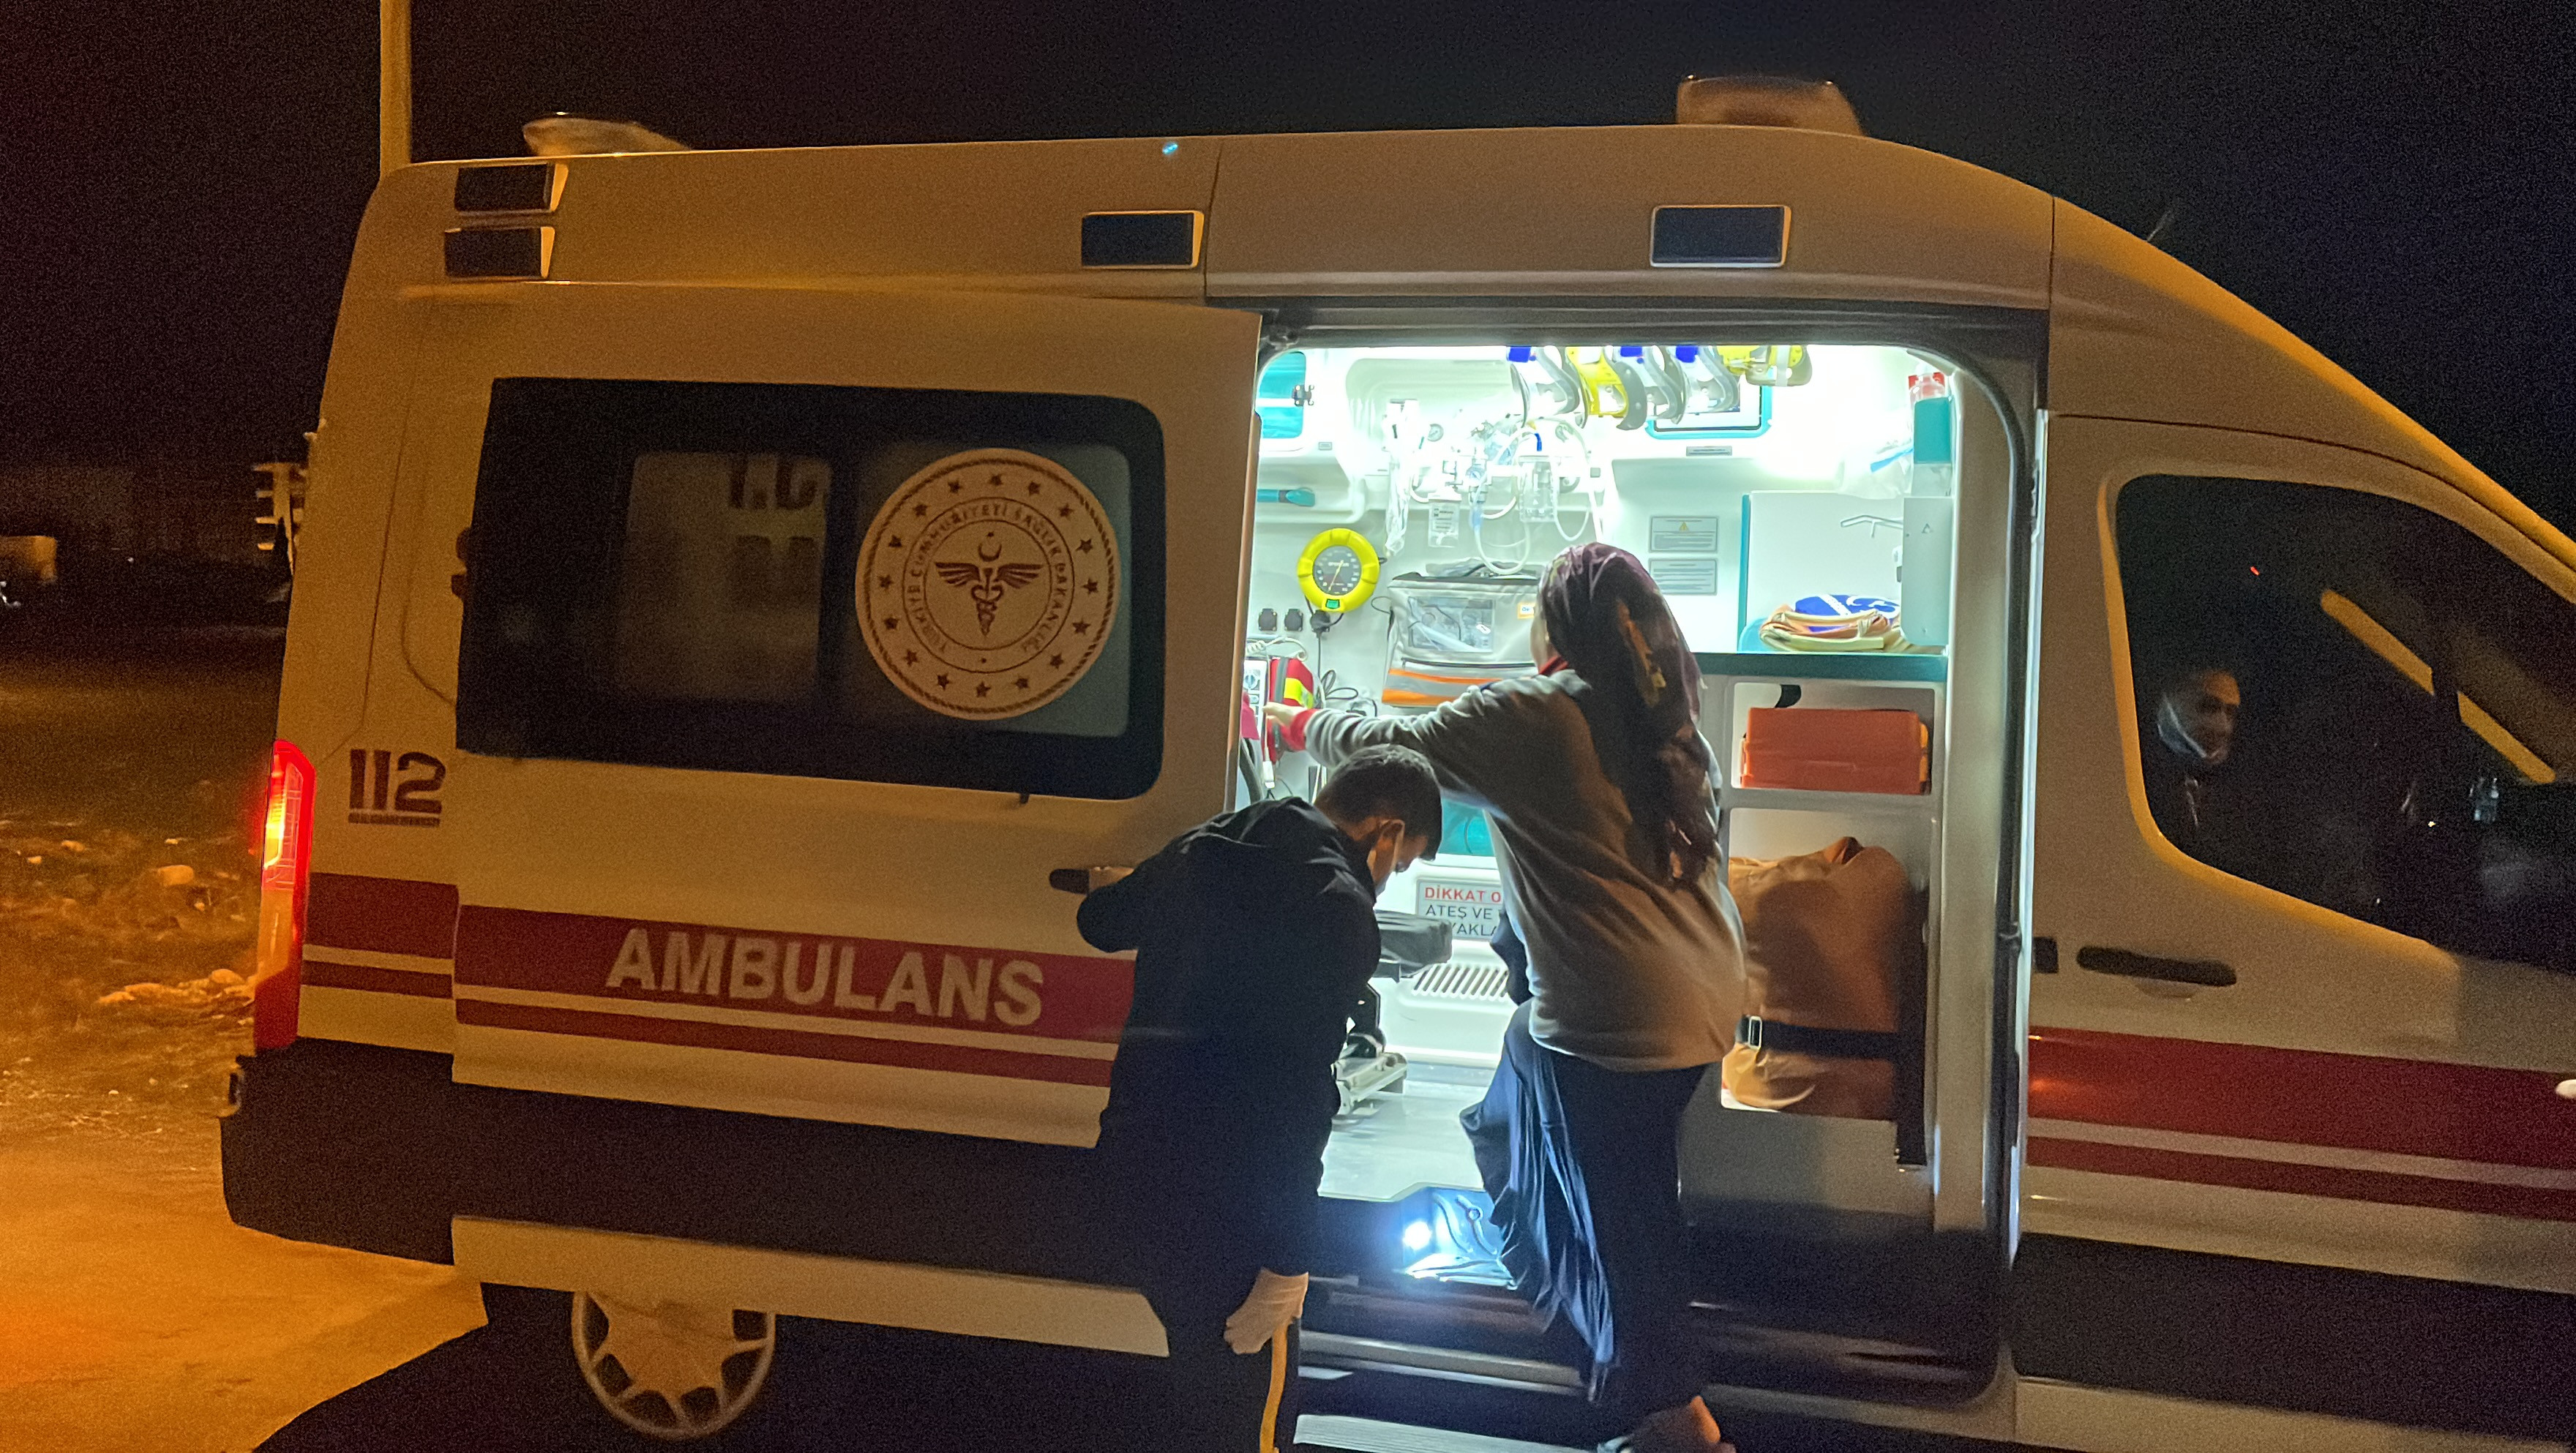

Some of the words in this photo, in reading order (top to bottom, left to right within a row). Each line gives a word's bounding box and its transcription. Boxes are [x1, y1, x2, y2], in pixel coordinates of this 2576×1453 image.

[348, 748, 446, 814] 112
[1425, 885, 1486, 902] DİKKAT
[1491, 891, 1502, 903] O
[1426, 904, 1467, 920] ATEŞ
[1472, 906, 1493, 920] VE
[605, 927, 1044, 1025] AMBULANS
